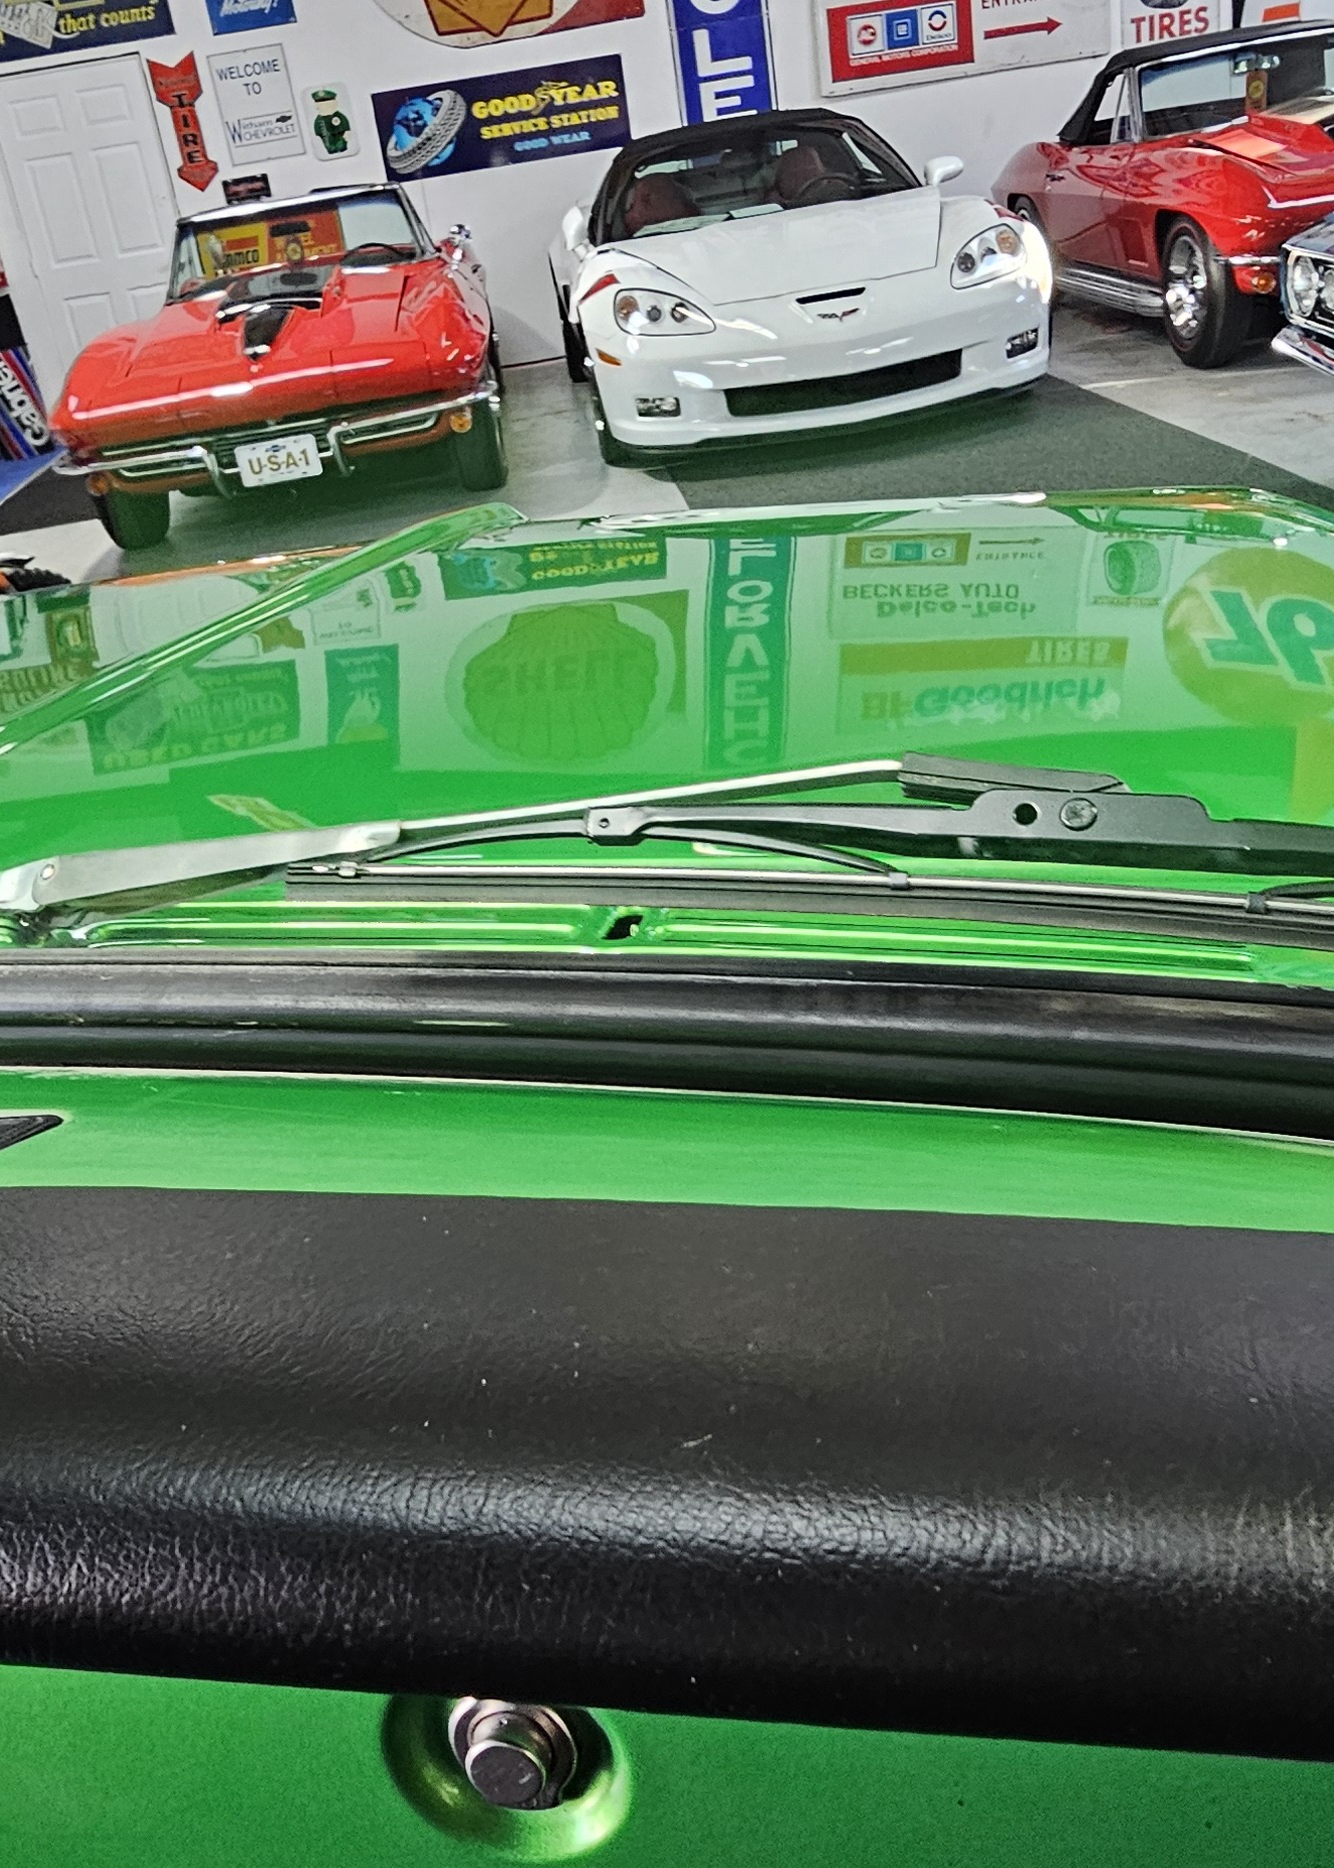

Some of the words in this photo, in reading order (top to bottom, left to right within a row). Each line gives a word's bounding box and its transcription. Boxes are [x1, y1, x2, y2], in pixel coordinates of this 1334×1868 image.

[58, 14, 96, 34] that
[1130, 6, 1210, 44] TIRES
[216, 58, 281, 81] WELCOME
[243, 82, 262, 96] TO
[550, 80, 620, 105] YEAR
[172, 93, 202, 165] TIRE
[243, 123, 296, 141] CHEVROLET
[480, 117, 550, 140] SERVICE
[549, 105, 620, 129] STATION
